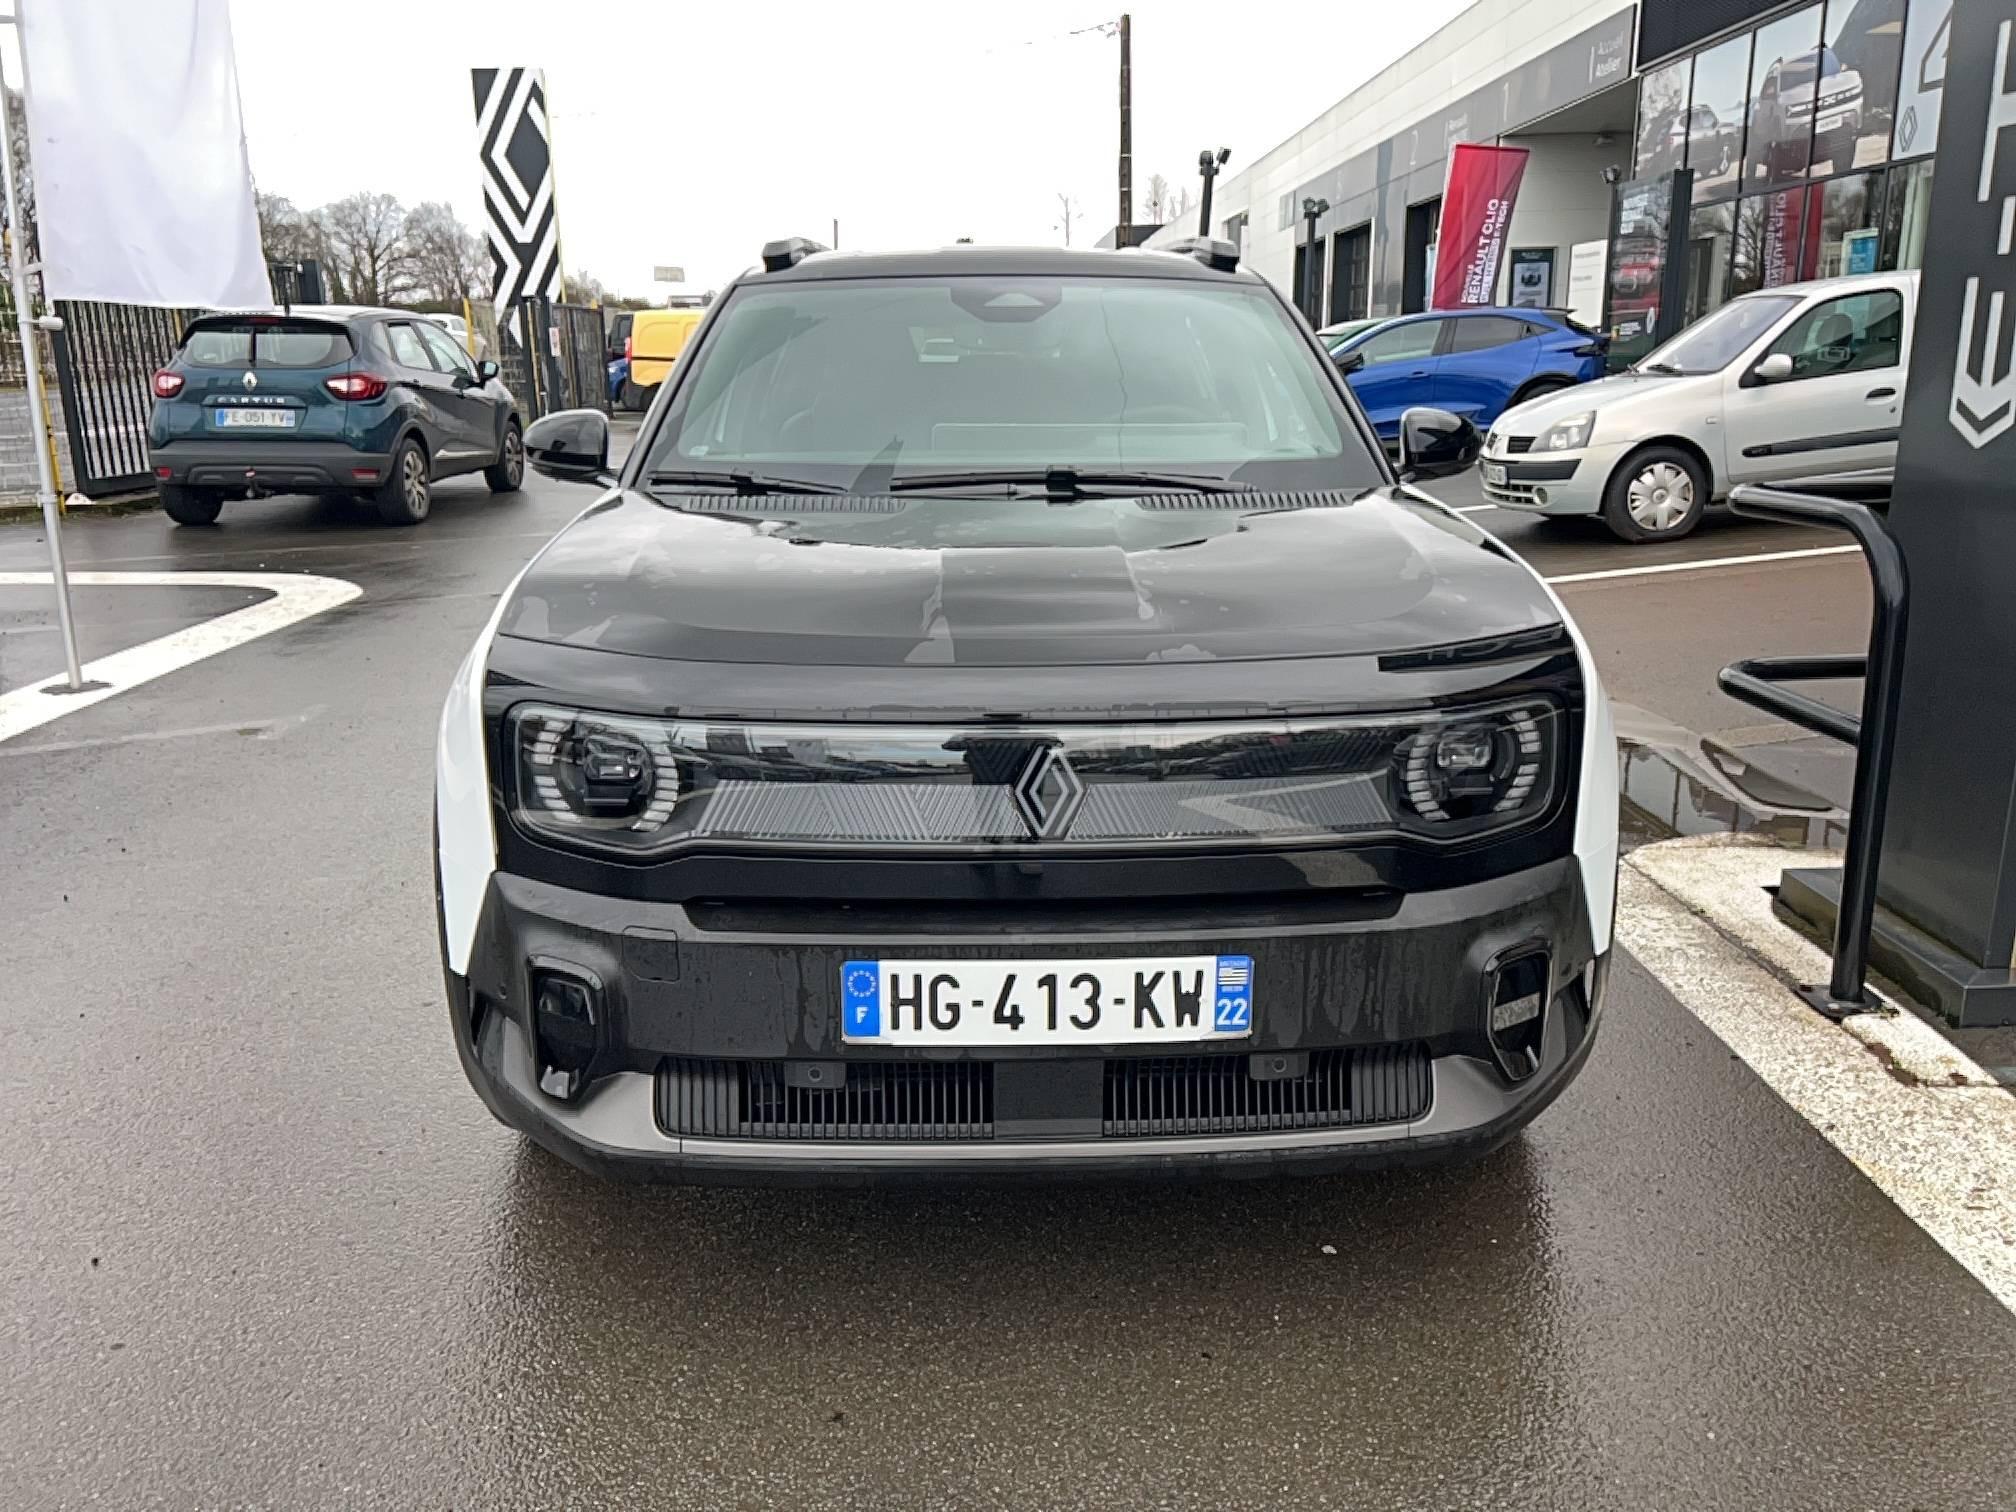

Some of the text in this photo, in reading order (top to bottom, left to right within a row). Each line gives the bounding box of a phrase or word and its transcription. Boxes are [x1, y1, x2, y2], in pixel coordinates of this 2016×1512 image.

[1467, 235, 1491, 304] RENAULT
[1481, 199, 1499, 235] CLIO
[856, 1006, 869, 1024] F
[889, 970, 1204, 1031] HG-413-KW
[1217, 997, 1248, 1026] 22
